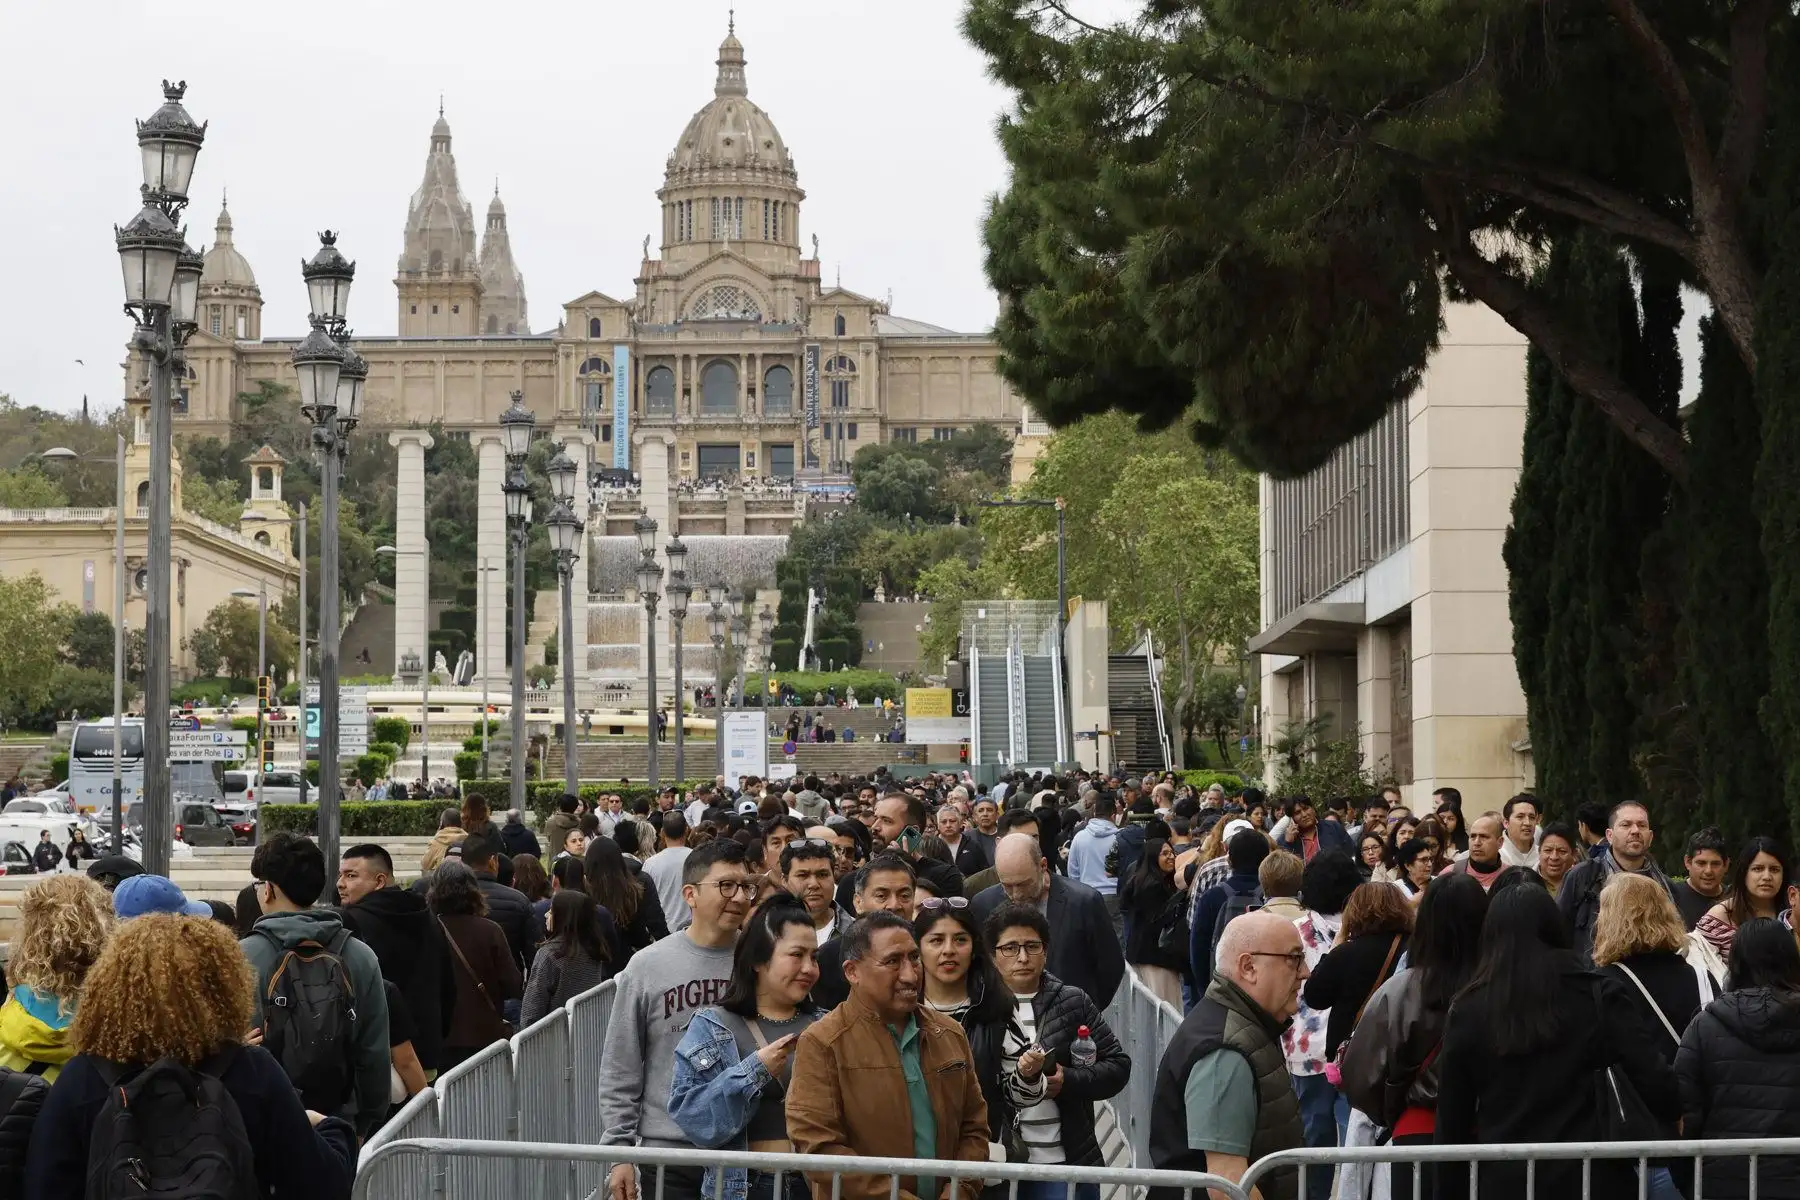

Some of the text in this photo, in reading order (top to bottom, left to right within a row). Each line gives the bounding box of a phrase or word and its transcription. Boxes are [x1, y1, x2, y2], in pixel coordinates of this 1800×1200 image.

[86, 566, 94, 578] 6
[170, 732, 211, 742] aixaForum
[192, 749, 203, 757] der
[205, 749, 221, 757] Rohe
[100, 786, 132, 795] Cals
